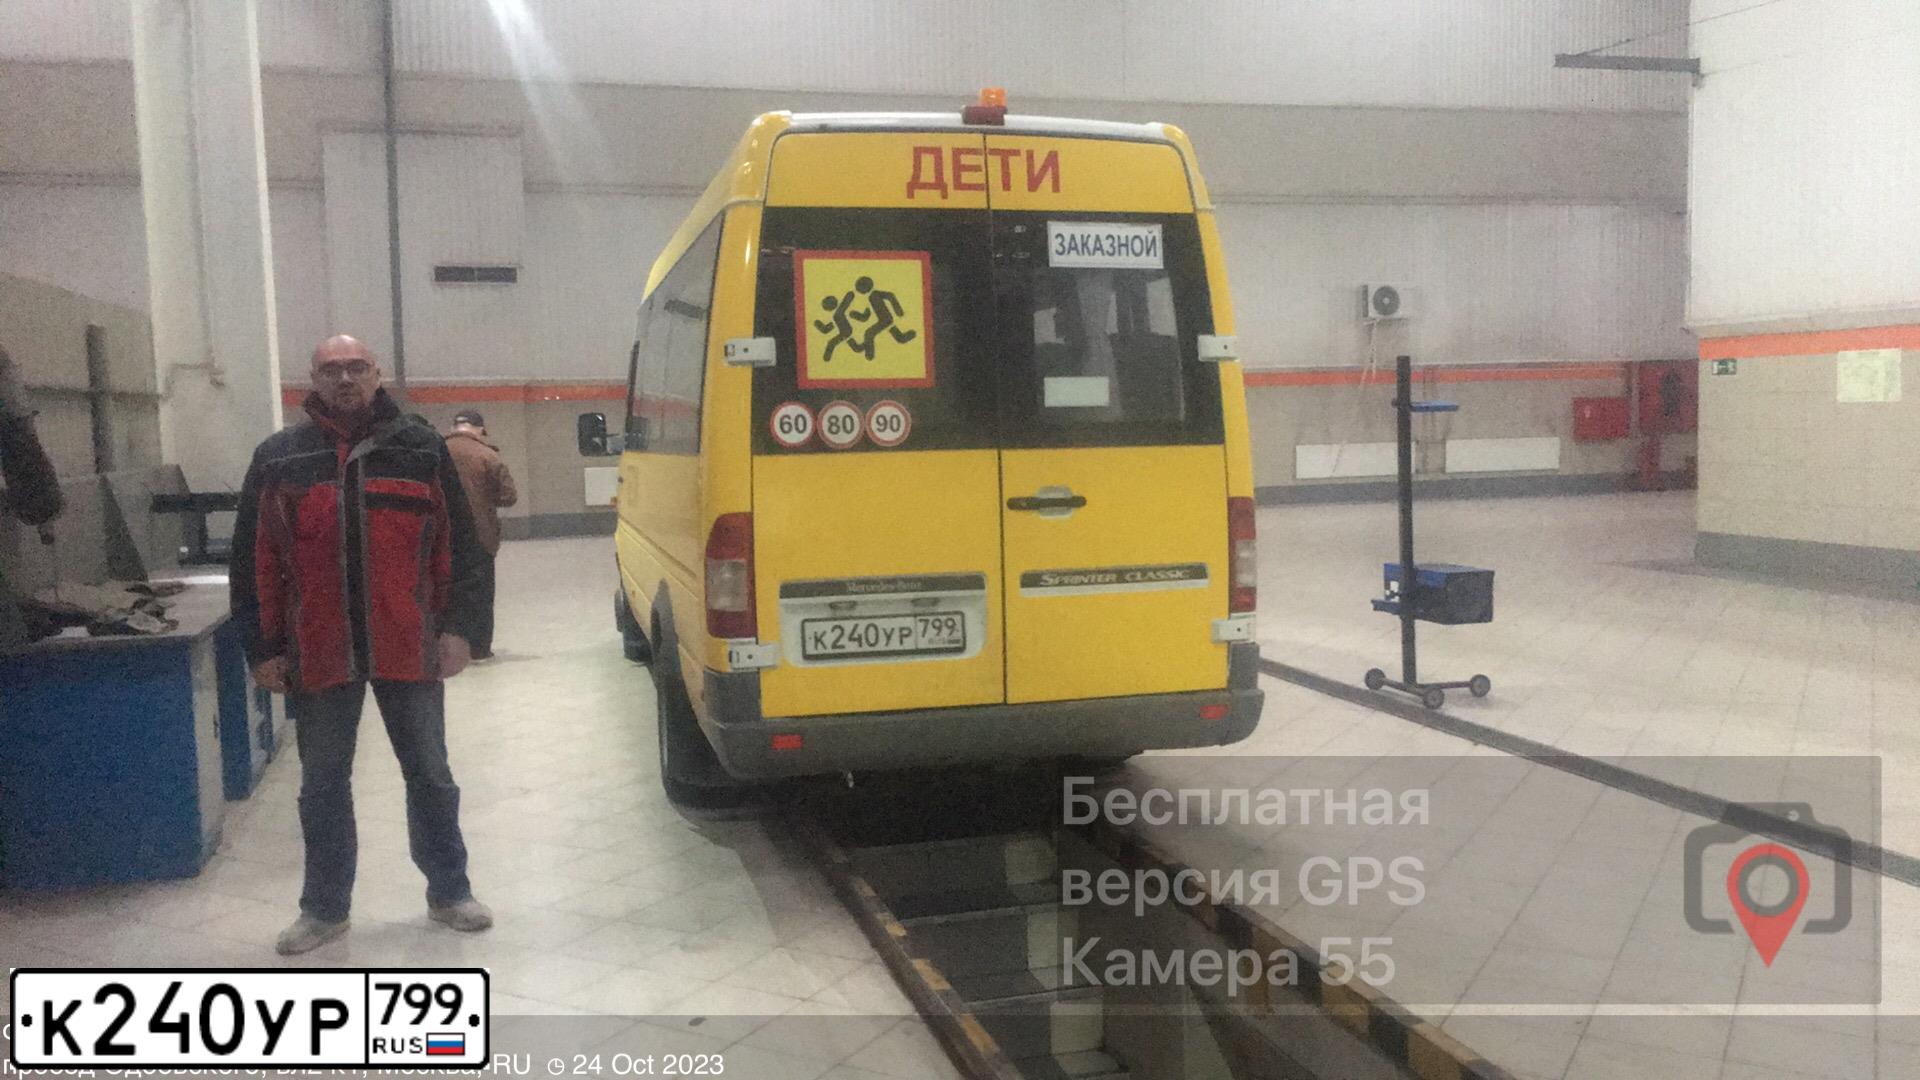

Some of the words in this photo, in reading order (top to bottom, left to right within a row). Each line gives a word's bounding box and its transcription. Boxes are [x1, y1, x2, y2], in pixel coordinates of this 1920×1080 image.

[906, 146, 1061, 199] ДЕТИ
[1054, 229, 1158, 258] ЗАКАЗНОЙ
[778, 413, 808, 435] 60
[826, 413, 856, 435] 80
[874, 412, 902, 434] 90
[918, 617, 957, 638] 799
